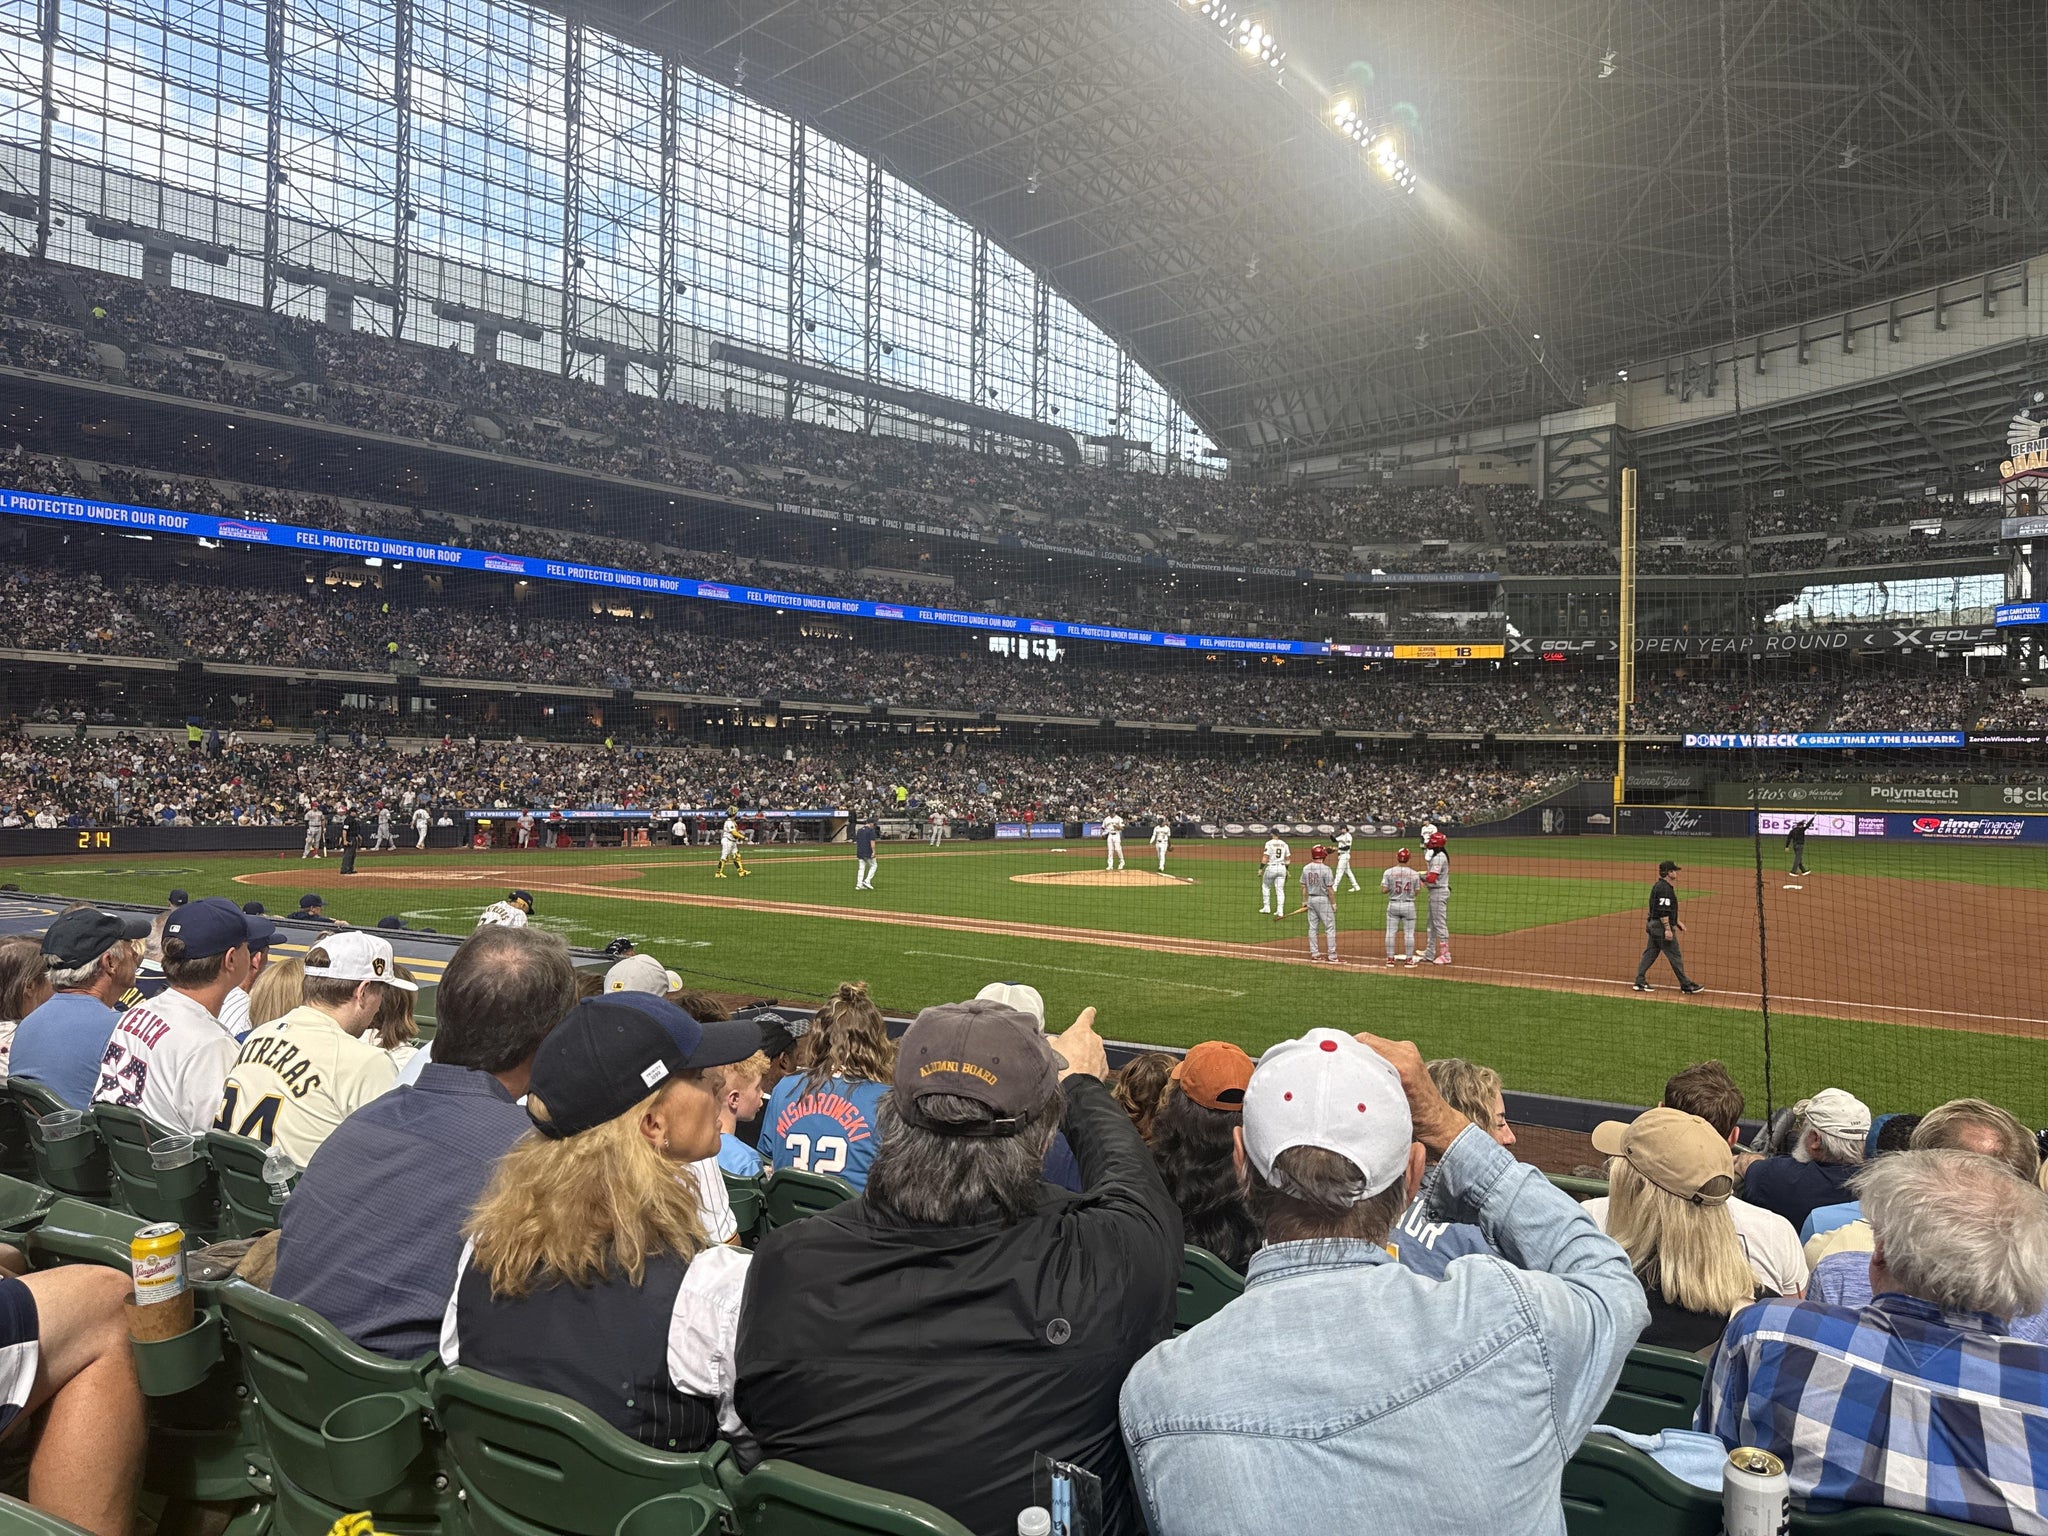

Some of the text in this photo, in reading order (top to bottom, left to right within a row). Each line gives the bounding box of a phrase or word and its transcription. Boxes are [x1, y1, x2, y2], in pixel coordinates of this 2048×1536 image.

[1999, 449, 2048, 478] CHAL
[11, 496, 84, 516] PROTECTED
[87, 505, 128, 522] UNDER
[131, 511, 156, 525] OUR
[158, 514, 190, 529] ROOF
[219, 526, 248, 534] AMERICAN
[296, 532, 462, 563] FEEL PROTECTED UNDER OUR ROOF
[1029, 540, 1072, 554] Northwestern
[1073, 548, 1096, 557] Mutual
[1101, 551, 1127, 561] LEGENDS
[1176, 561, 1221, 571] Northwestern
[1223, 565, 1246, 573] Mutual
[1252, 567, 1280, 575] LEGENDS
[547, 564, 680, 591] FEEL PROTECTED UNDER OUR ROOF
[747, 591, 860, 612] FEEL PROTECTED UNDER OUR ROOF
[919, 610, 1017, 628] FEEL PROTECTED UNDER OUR ROOF
[1068, 625, 1153, 642] FEEL PROTECTED UNDER OUR ROOF
[1541, 640, 1596, 650] GOLF
[1630, 638, 1689, 652] OPEN
[1766, 633, 1848, 650] ROUND
[1930, 629, 1997, 642] GOLF
[1200, 638, 1292, 651] FEEL PROTECTED UNDER OUR ROOF
[1685, 734, 1799, 747] DON'T WRECK
[1808, 736, 1841, 744] GREAT
[1842, 736, 1867, 744] TIME
[1902, 735, 1960, 744] BALLPARK.
[1626, 775, 1691, 788] Barrel Yard
[1870, 786, 1959, 799] Polymatech
[2024, 787, 2048, 801] clo
[1762, 820, 1780, 829] Be
[1275, 848, 1282, 858] 9
[1395, 881, 1412, 894] 54
[117, 1007, 171, 1051] YELICH
[920, 1061, 960, 1078] ALUMNI
[961, 1062, 998, 1086] BOARD
[785, 1133, 848, 1174] 32
